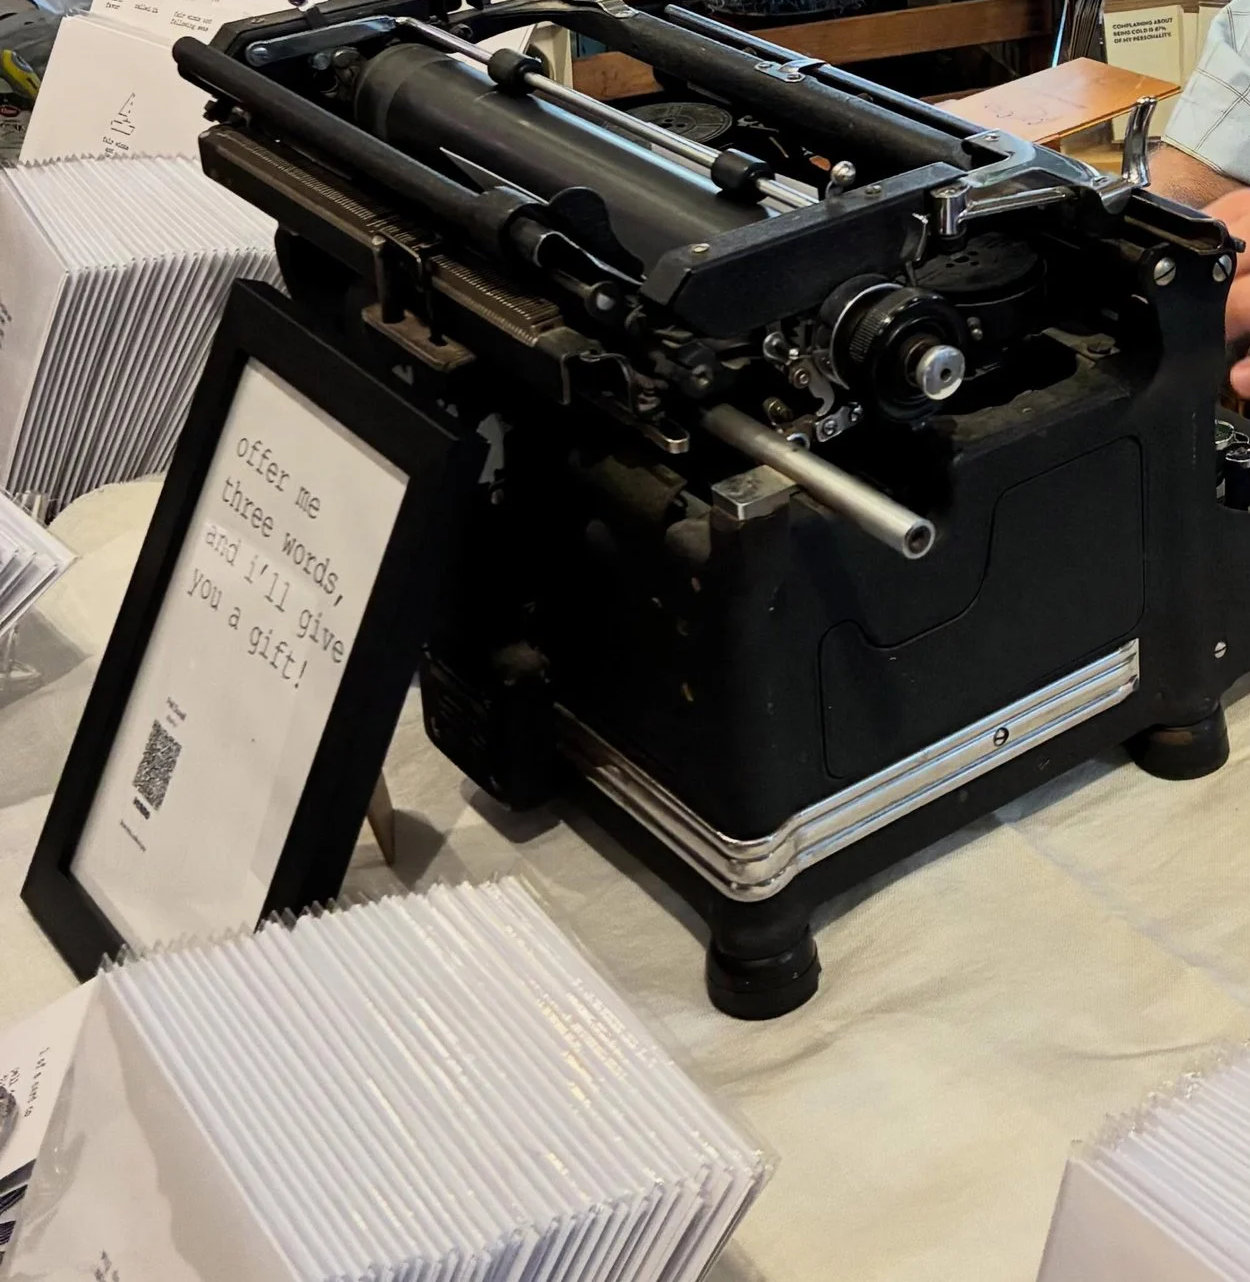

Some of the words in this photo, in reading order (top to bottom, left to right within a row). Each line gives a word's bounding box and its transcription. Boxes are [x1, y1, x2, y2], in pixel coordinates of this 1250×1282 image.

[1113, 21, 1153, 29] COMPLAINING
[236, 437, 290, 492] offer
[295, 486, 321, 519] me
[205, 526, 242, 567] and
[244, 554, 290, 613] i'll
[296, 609, 345, 664] give
[222, 476, 274, 538] three
[282, 532, 343, 607] words,
[187, 568, 223, 611] you
[228, 606, 242, 630] a
[247, 626, 308, 689] gift!
